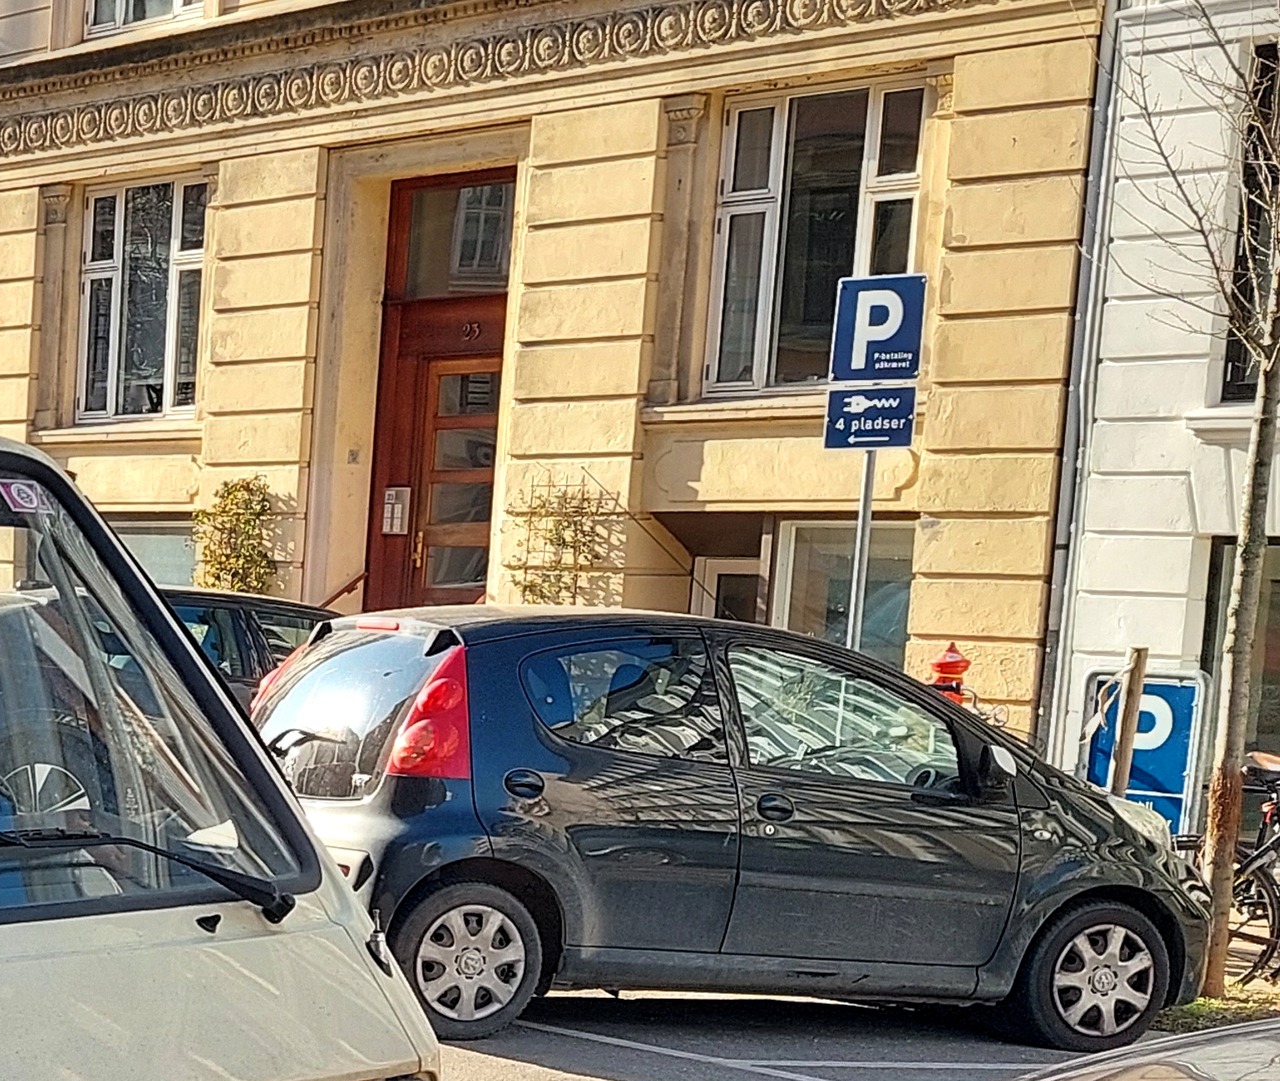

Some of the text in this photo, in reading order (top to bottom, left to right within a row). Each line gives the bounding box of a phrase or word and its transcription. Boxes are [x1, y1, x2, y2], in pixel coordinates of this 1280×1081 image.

[462, 323, 481, 341] 23
[851, 289, 905, 370] P
[873, 352, 913, 361] P-betaling
[834, 416, 907, 433] 4 pladser
